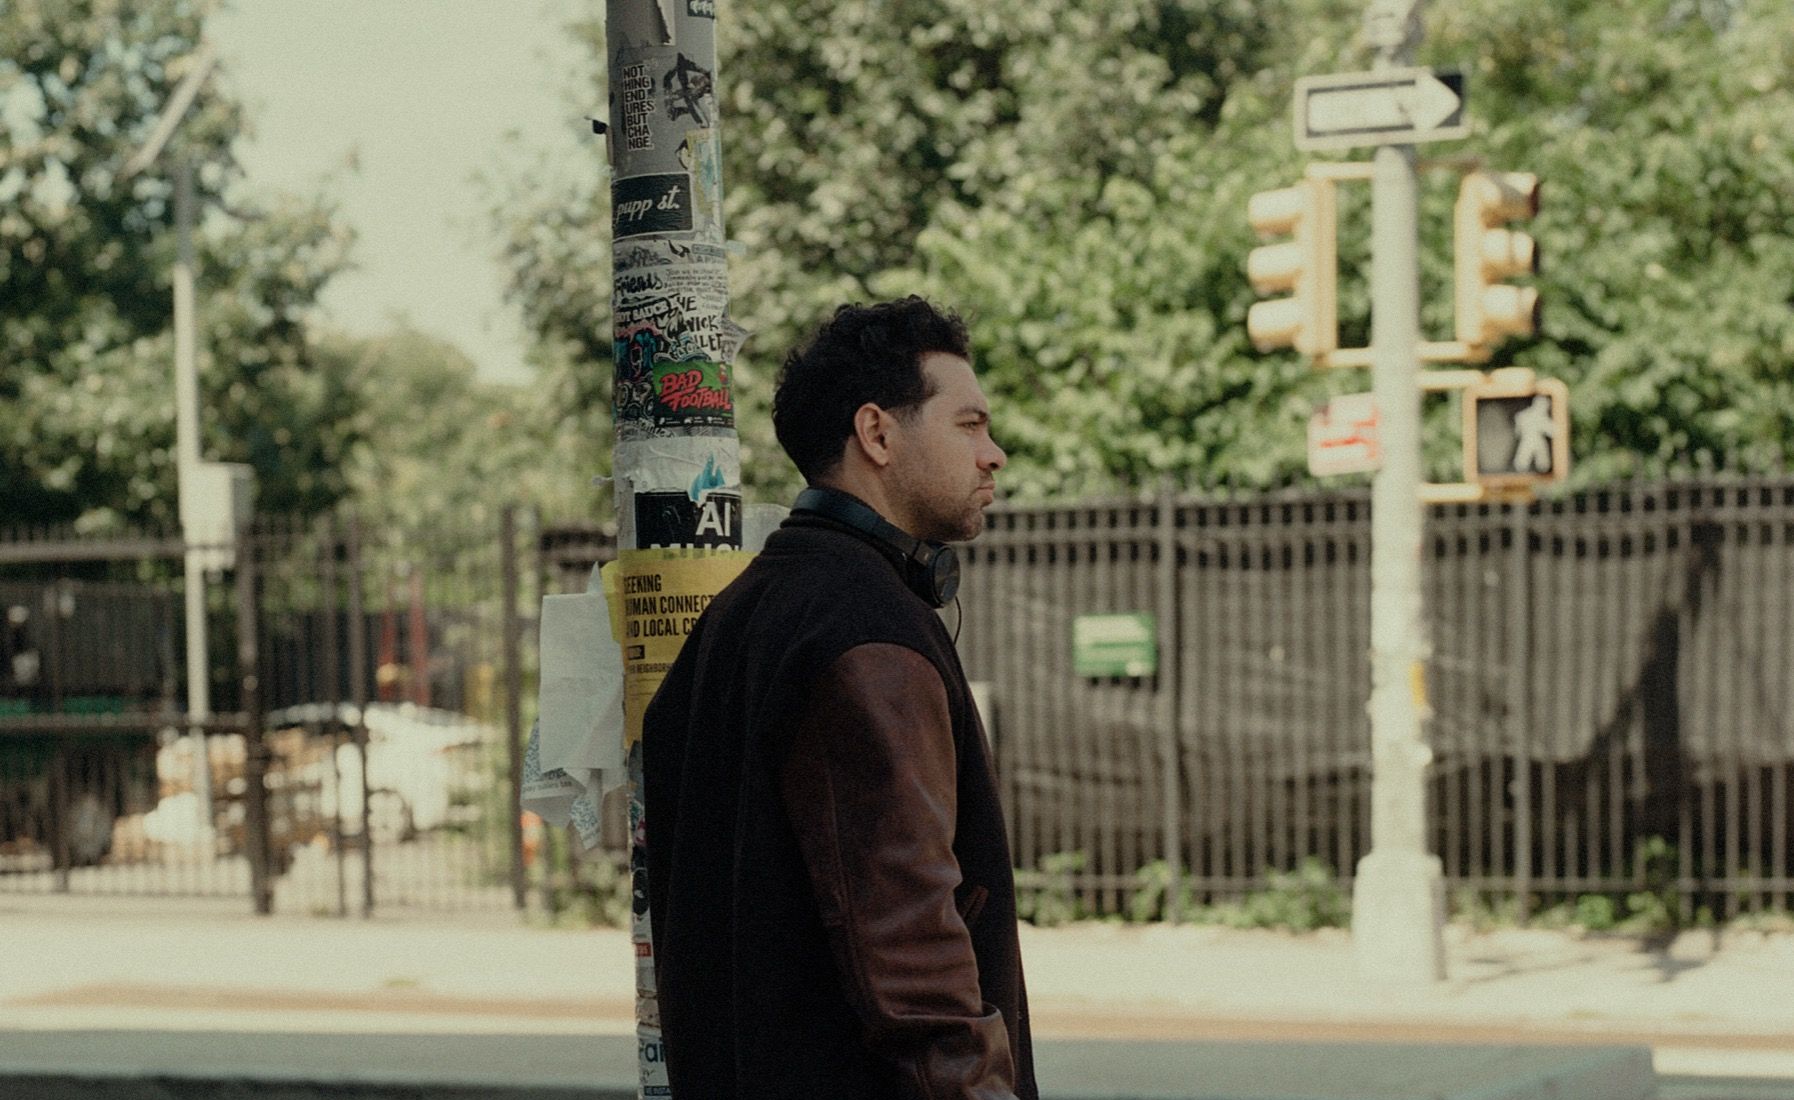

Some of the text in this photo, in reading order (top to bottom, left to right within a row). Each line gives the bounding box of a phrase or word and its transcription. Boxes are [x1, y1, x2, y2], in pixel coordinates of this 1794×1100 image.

[623, 65, 645, 79] NOT
[624, 77, 650, 91] HING
[625, 89, 646, 102] END
[626, 101, 655, 114] URES
[627, 113, 648, 126] BUT
[628, 125, 650, 138] CHA
[660, 370, 703, 394] BAD
[643, 618, 680, 637] LOCAL
